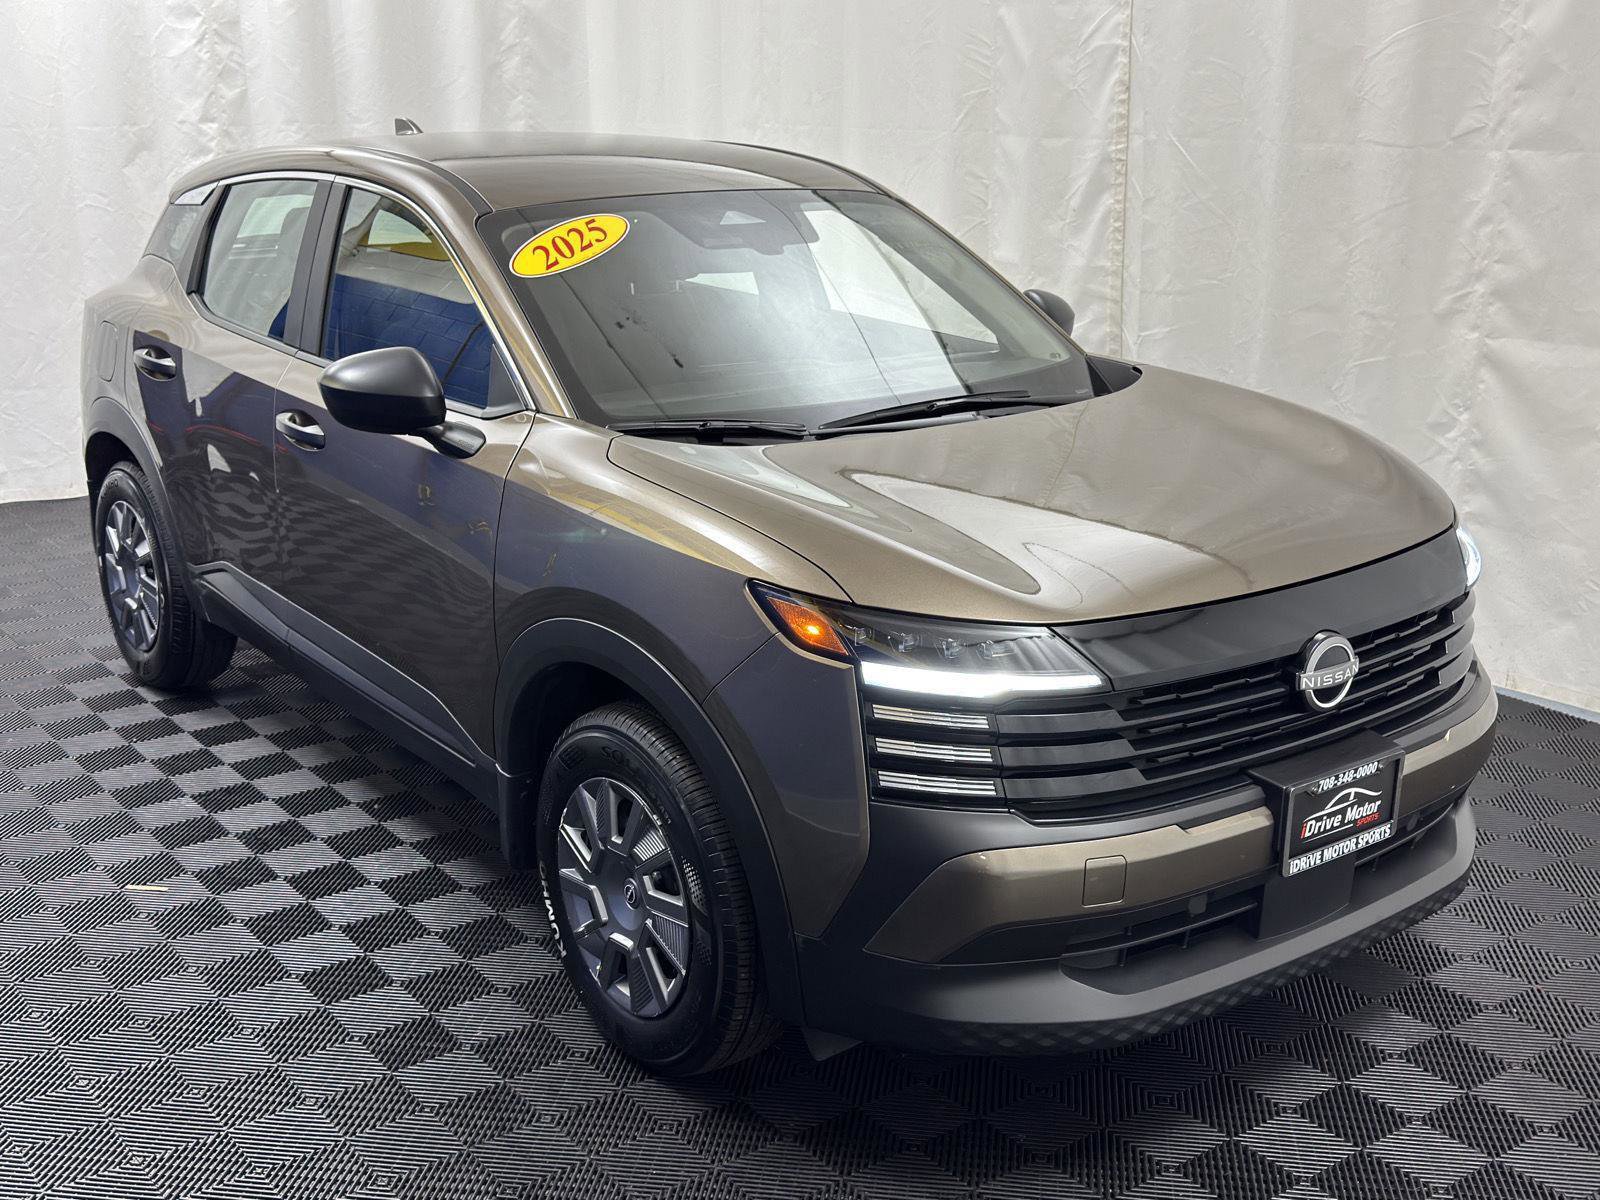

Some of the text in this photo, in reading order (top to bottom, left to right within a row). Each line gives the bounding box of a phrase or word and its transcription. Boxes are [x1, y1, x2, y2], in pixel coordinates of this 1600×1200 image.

[532, 219, 608, 271] 2025
[1302, 663, 1359, 689] NISSAN
[1318, 762, 1379, 792] 708-348-0000
[1300, 800, 1382, 839] iDrive Motor
[1356, 812, 1380, 827] SPORTS
[1322, 839, 1357, 861] MOTOR
[1357, 824, 1392, 849] SPORTS
[540, 860, 567, 959] KUMHO
